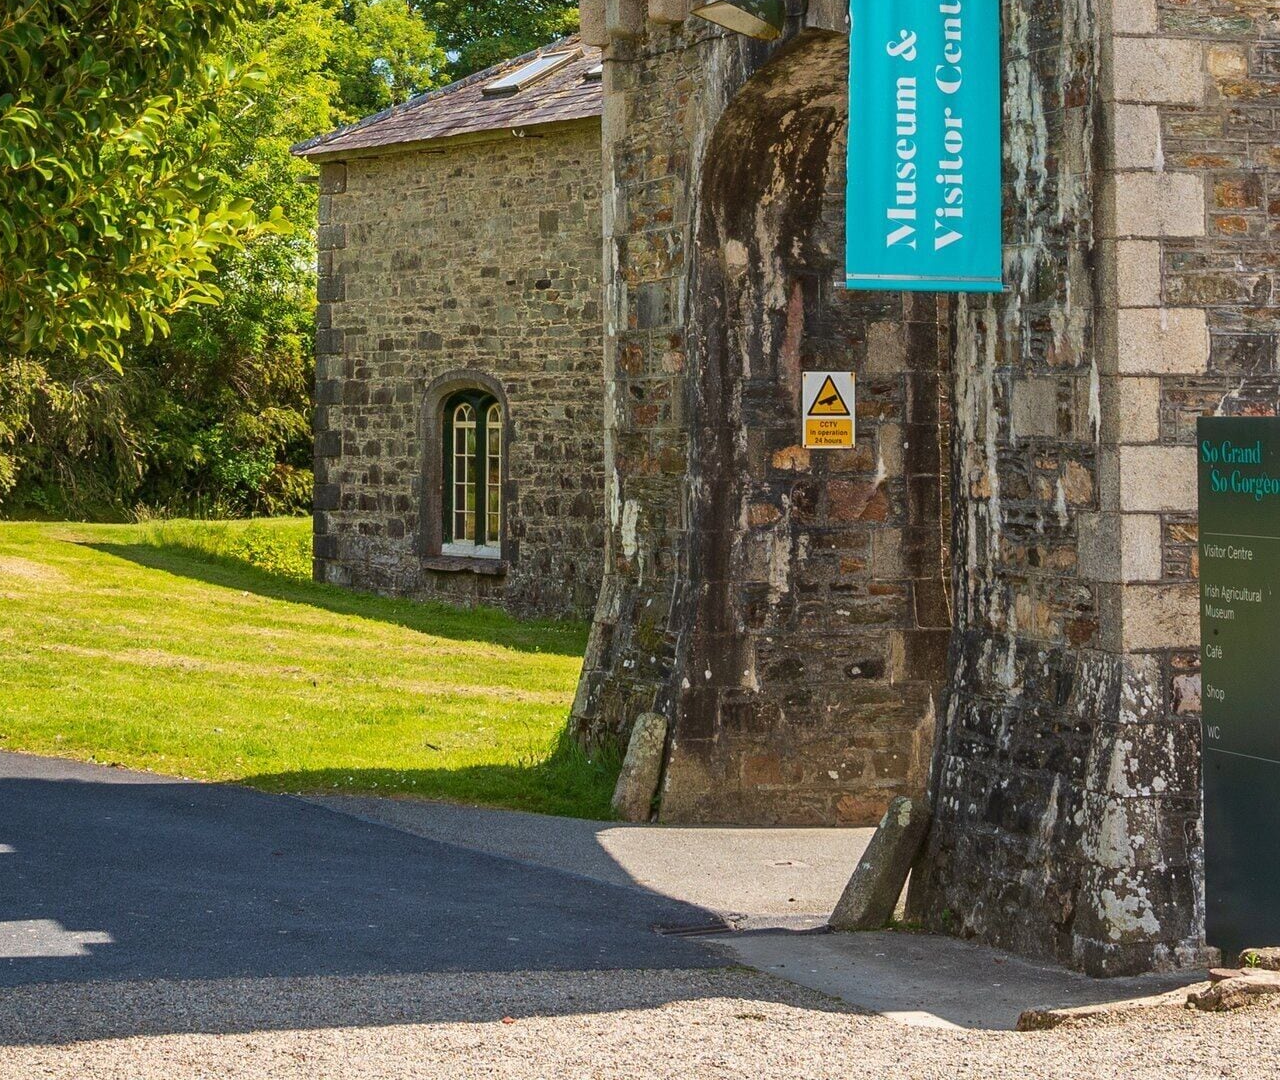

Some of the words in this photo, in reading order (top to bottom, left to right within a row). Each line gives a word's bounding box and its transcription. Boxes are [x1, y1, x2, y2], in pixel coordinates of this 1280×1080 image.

[886, 29, 917, 62] &
[886, 76, 917, 251] Museum
[934, 107, 964, 251] Visitor
[817, 429, 848, 437] operation
[1202, 440, 1219, 463] So
[1221, 440, 1261, 464] Grand
[1211, 469, 1228, 493] So
[1203, 543, 1227, 559] Visitor
[1227, 545, 1253, 561] Centre
[1204, 583, 1220, 599] Irish
[1220, 585, 1262, 603] Agricultural
[1205, 603, 1235, 620] Museum
[1206, 644, 1223, 659] Café
[1206, 683, 1225, 702] Shop
[1207, 724, 1221, 740] WC
